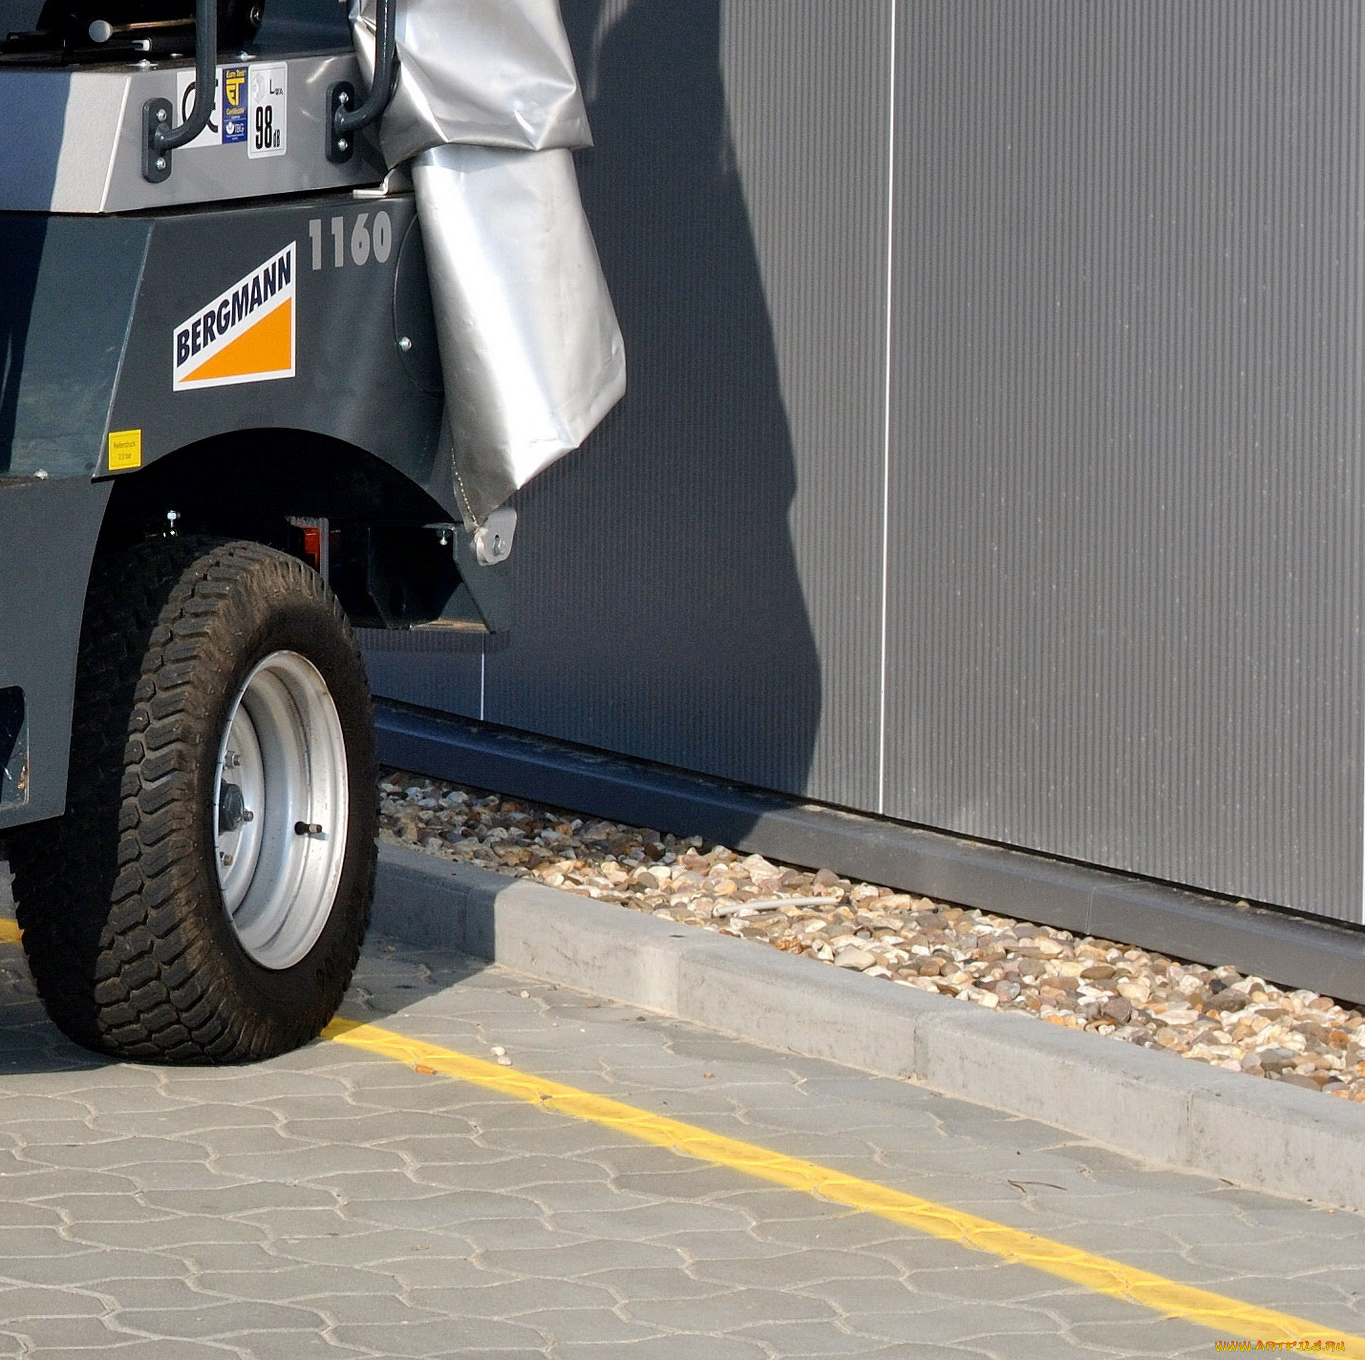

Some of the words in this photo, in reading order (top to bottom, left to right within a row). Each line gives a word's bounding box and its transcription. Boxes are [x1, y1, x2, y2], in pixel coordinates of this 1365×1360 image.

[256, 105, 272, 149] 98
[309, 210, 392, 271] 1160
[176, 249, 292, 369] BERGMANN
